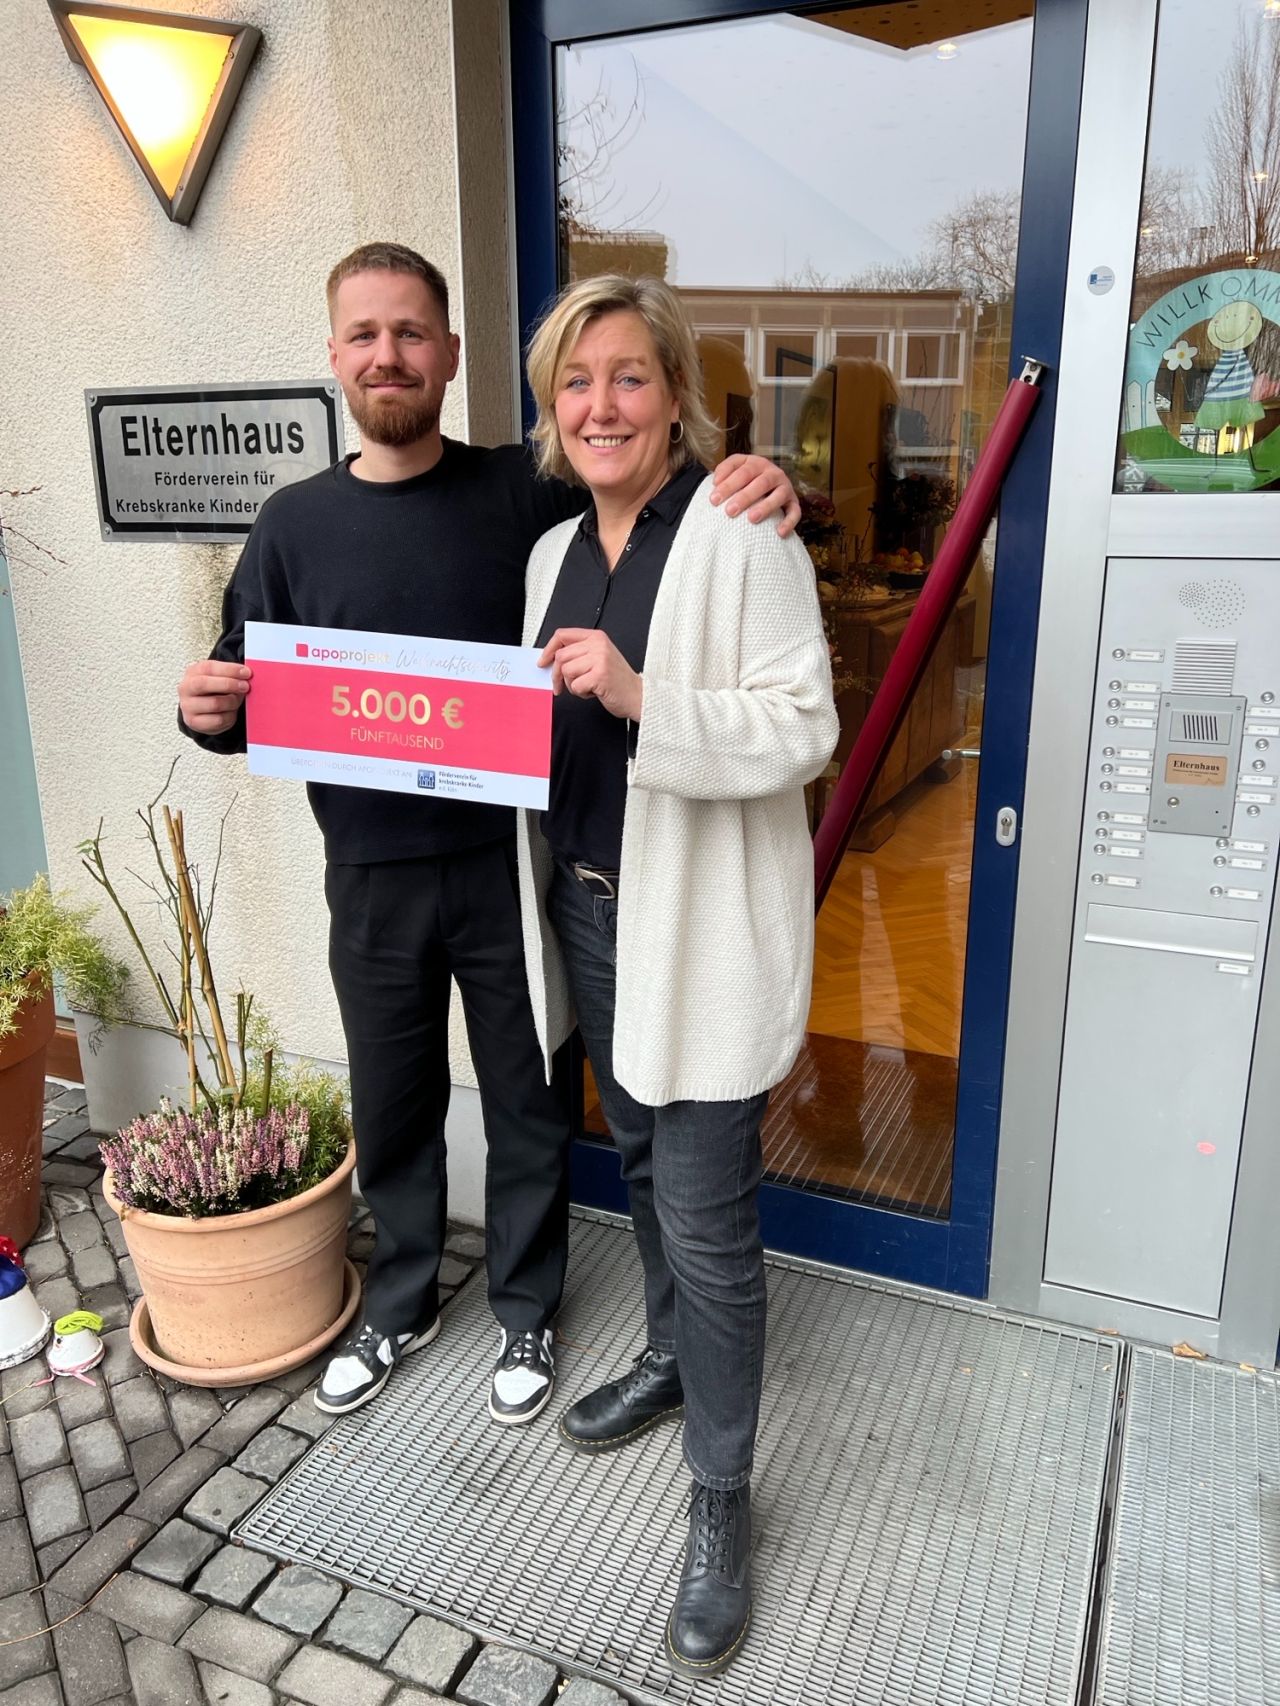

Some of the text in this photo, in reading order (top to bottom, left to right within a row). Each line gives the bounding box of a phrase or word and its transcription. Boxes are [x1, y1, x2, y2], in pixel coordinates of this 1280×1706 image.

[120, 413, 305, 457] Elternhaus
[154, 470, 276, 486] Förderverein für
[116, 498, 259, 514] Krebskranke Kinder
[311, 647, 391, 666] apoprojekt
[331, 685, 465, 729] 5.000 €
[350, 726, 445, 751] FÜNFTAUSEND
[1173, 760, 1220, 771] Elternhaus
